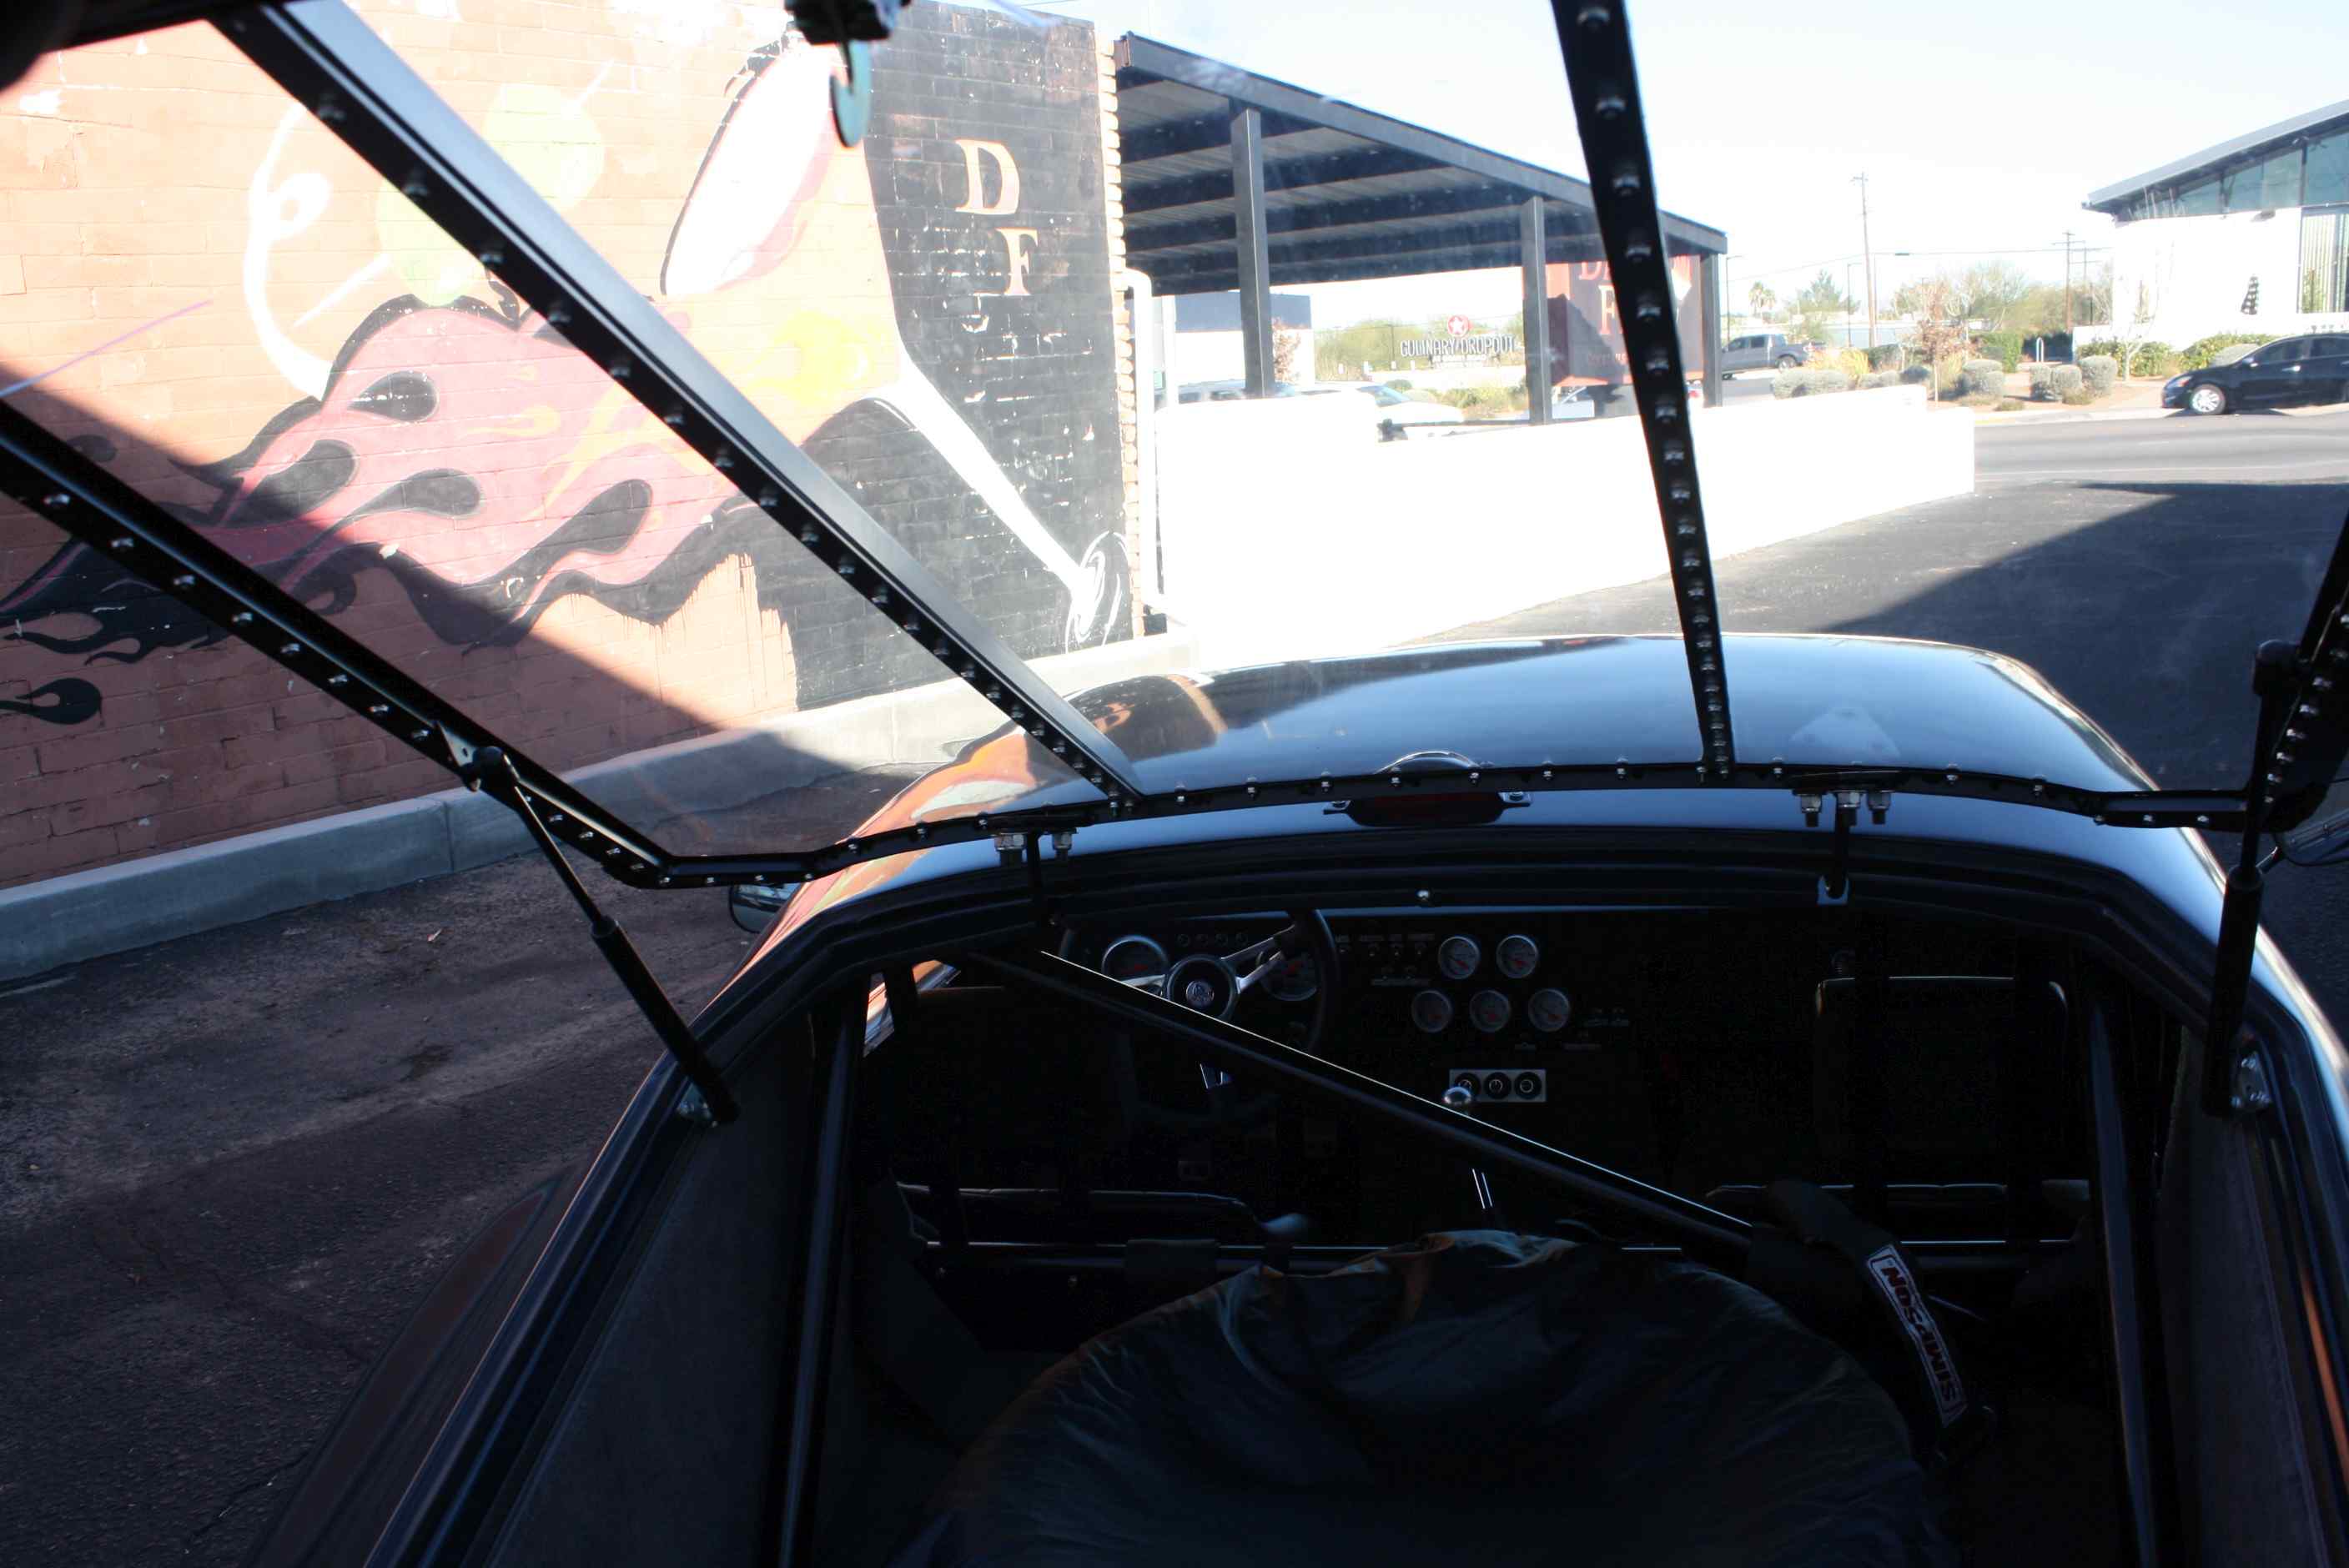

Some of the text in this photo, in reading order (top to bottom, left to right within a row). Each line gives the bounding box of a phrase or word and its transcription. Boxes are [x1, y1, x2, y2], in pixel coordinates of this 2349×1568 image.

[955, 139, 1020, 215] D
[996, 228, 1039, 296] F
[1400, 335, 1515, 357] CULINARY DROPOUT
[1880, 1266, 1959, 1402] SIMPSON
